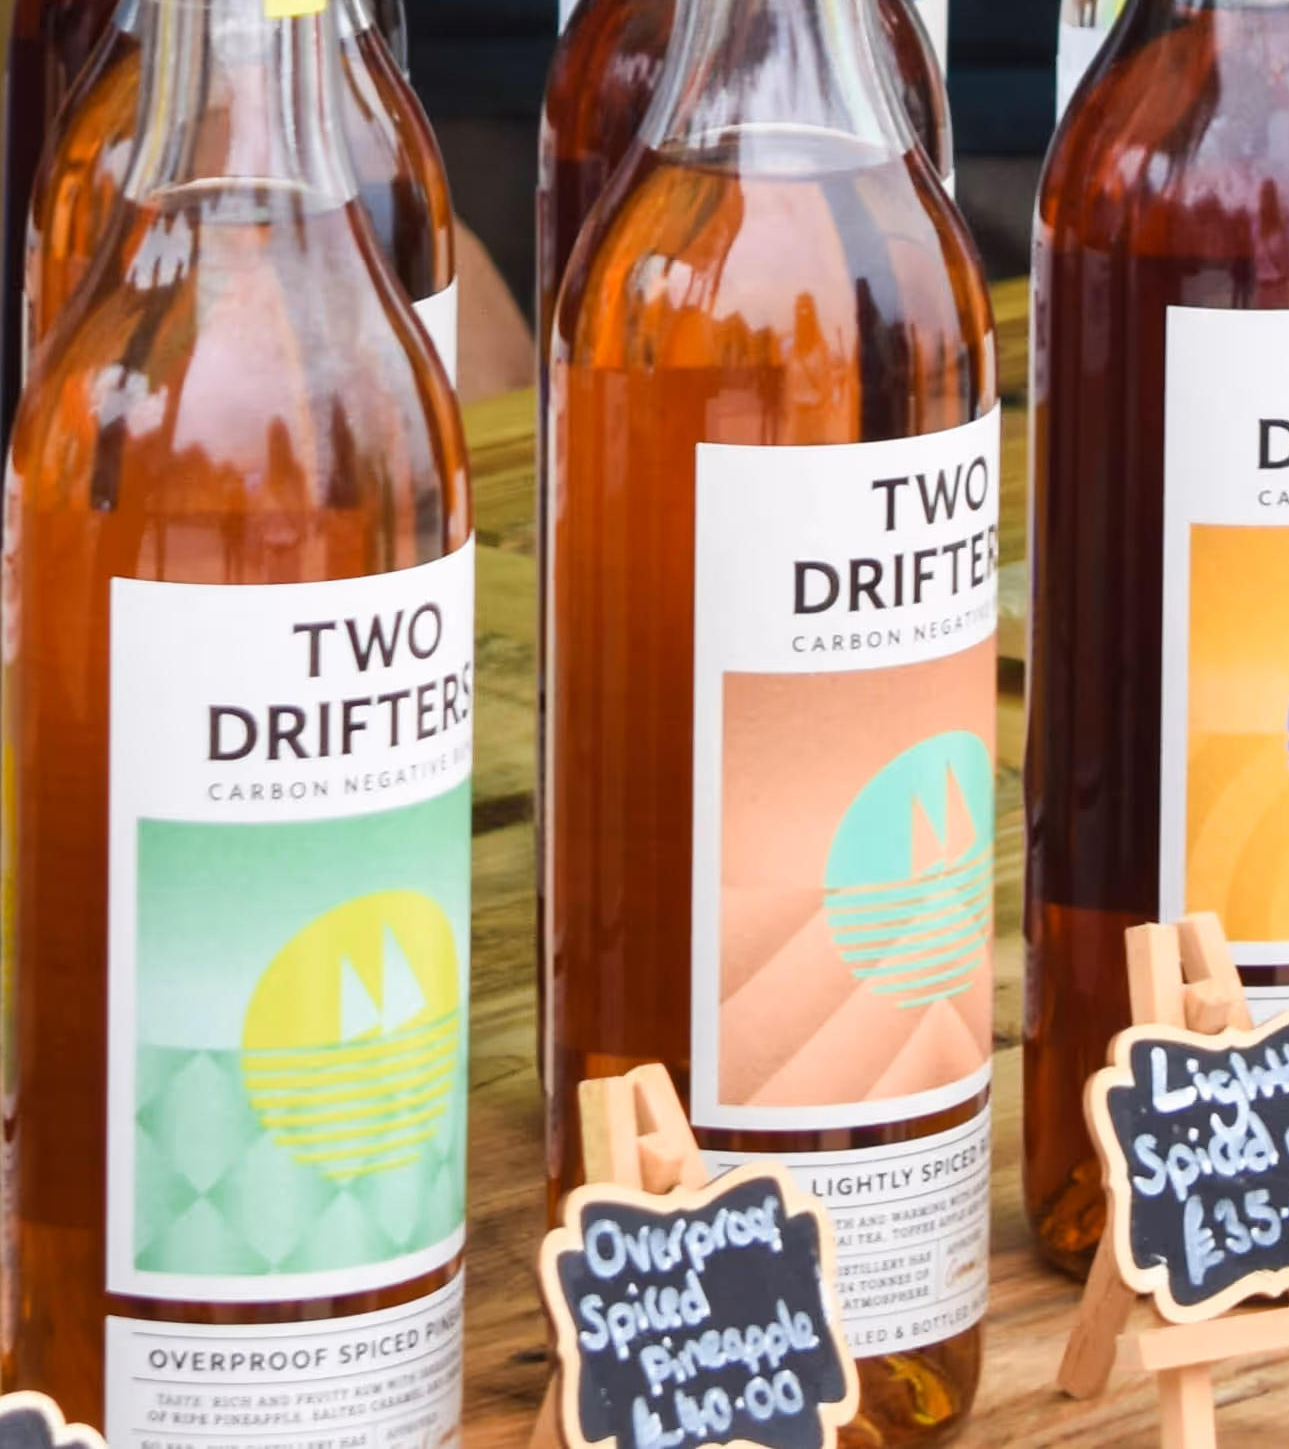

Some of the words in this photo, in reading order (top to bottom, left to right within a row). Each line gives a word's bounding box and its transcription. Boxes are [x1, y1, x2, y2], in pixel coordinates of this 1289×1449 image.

[872, 455, 989, 532] TWO
[293, 601, 443, 678] TWO
[792, 630, 901, 653] CARBON
[208, 781, 330, 802] CARBON
[811, 1168, 913, 1198] LIGHTLY
[921, 1144, 977, 1183] SPICED
[584, 1195, 783, 1279] Overproof
[857, 1214, 888, 1227] AND
[841, 1285, 930, 1310] ATMOSPHERE
[860, 1272, 912, 1291] TONNES
[914, 1268, 929, 1280] OF
[579, 1268, 712, 1360] Spiced
[894, 1326, 905, 1340] &
[911, 1305, 970, 1336] BOTTLED
[148, 1348, 329, 1372] OVERPROOF
[338, 1328, 420, 1365] SPICED
